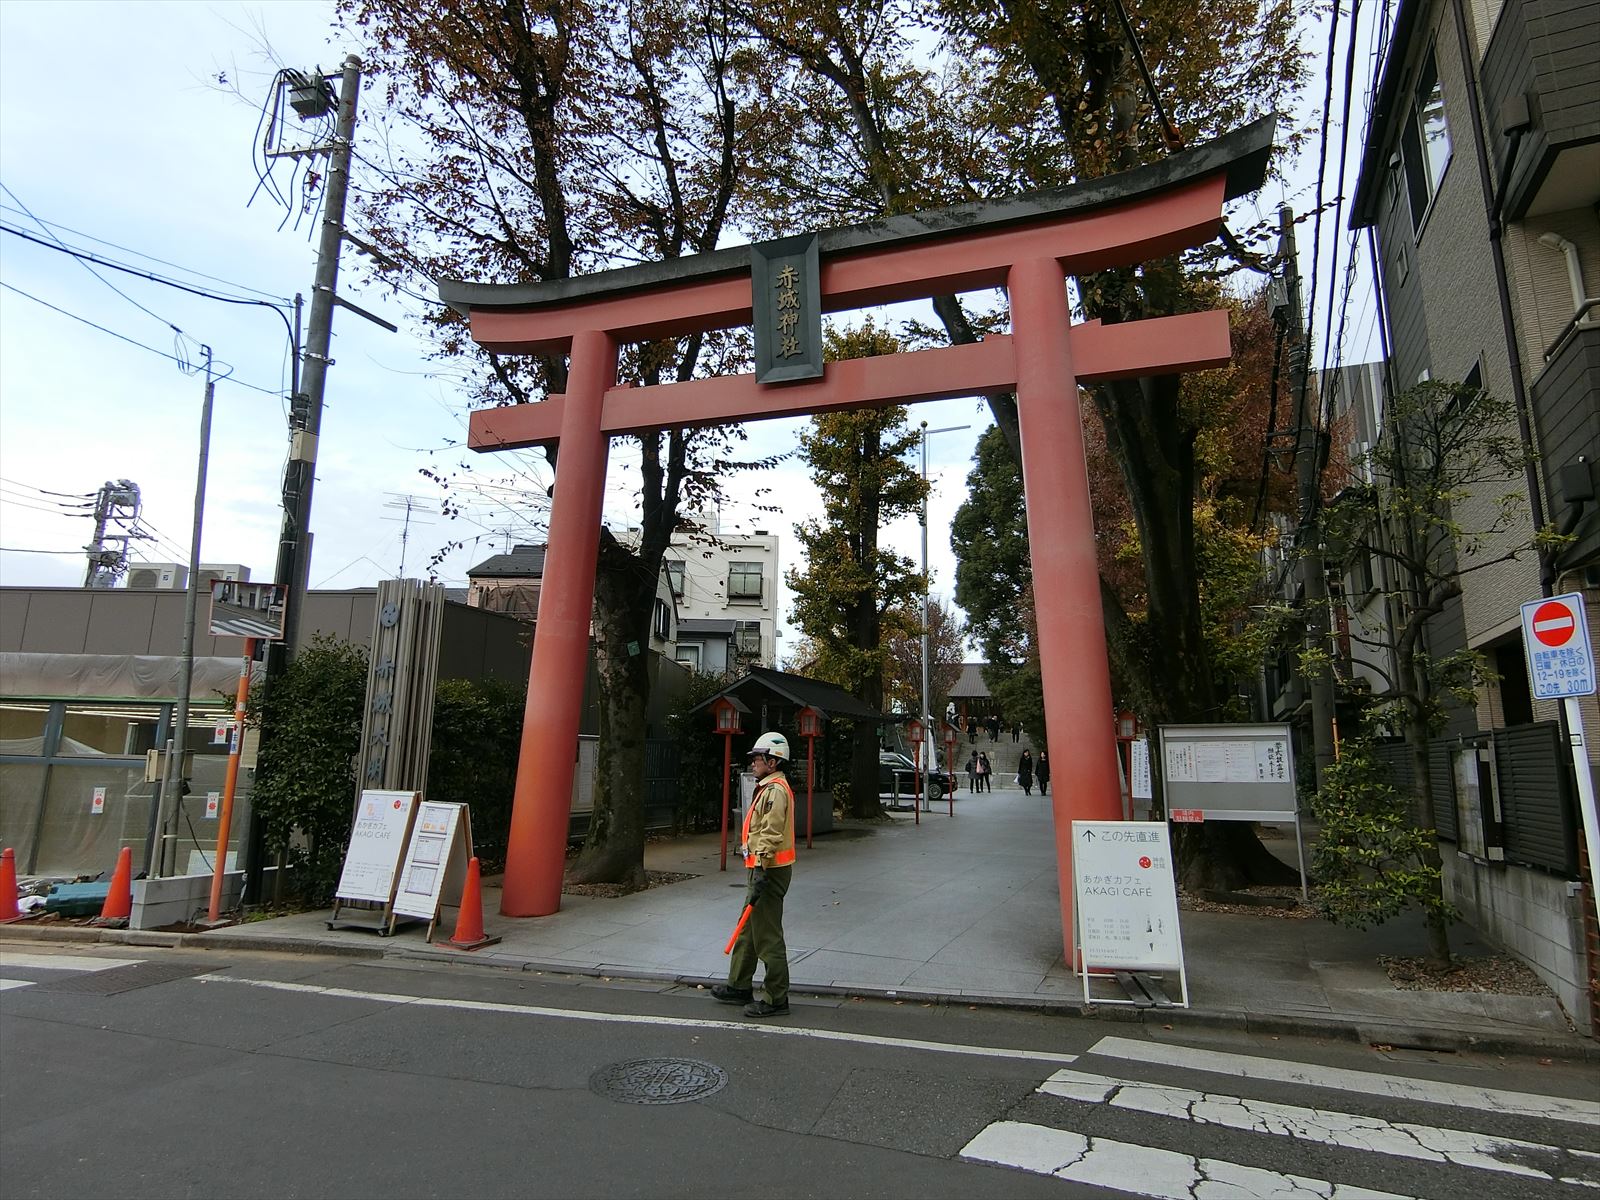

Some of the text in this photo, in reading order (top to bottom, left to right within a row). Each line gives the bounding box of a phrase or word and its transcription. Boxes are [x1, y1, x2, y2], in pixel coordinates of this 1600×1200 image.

[775, 264, 803, 359] 赤城神社
[1534, 647, 1583, 660] 自転車を除く
[1540, 679, 1588, 695] この先 30m
[354, 830, 374, 838] AKAGI
[1101, 831, 1161, 843] この先直進
[1083, 875, 1142, 885] あかぎカフェ
[1084, 887, 1119, 896] AKAGI
